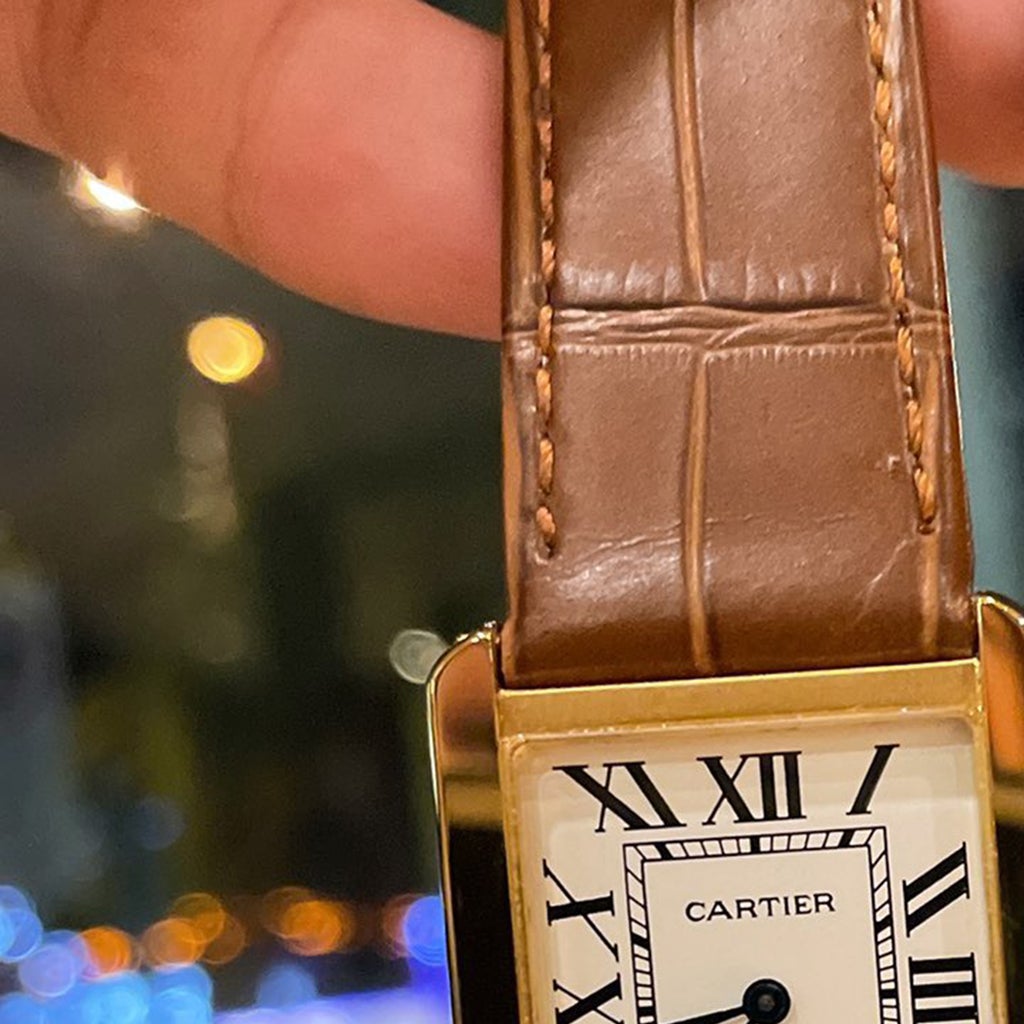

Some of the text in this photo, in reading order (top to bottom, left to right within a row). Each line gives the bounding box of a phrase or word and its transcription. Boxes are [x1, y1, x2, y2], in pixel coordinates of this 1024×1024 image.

[552, 743, 900, 832] XI XII I
[685, 892, 836, 923] CARTIER
